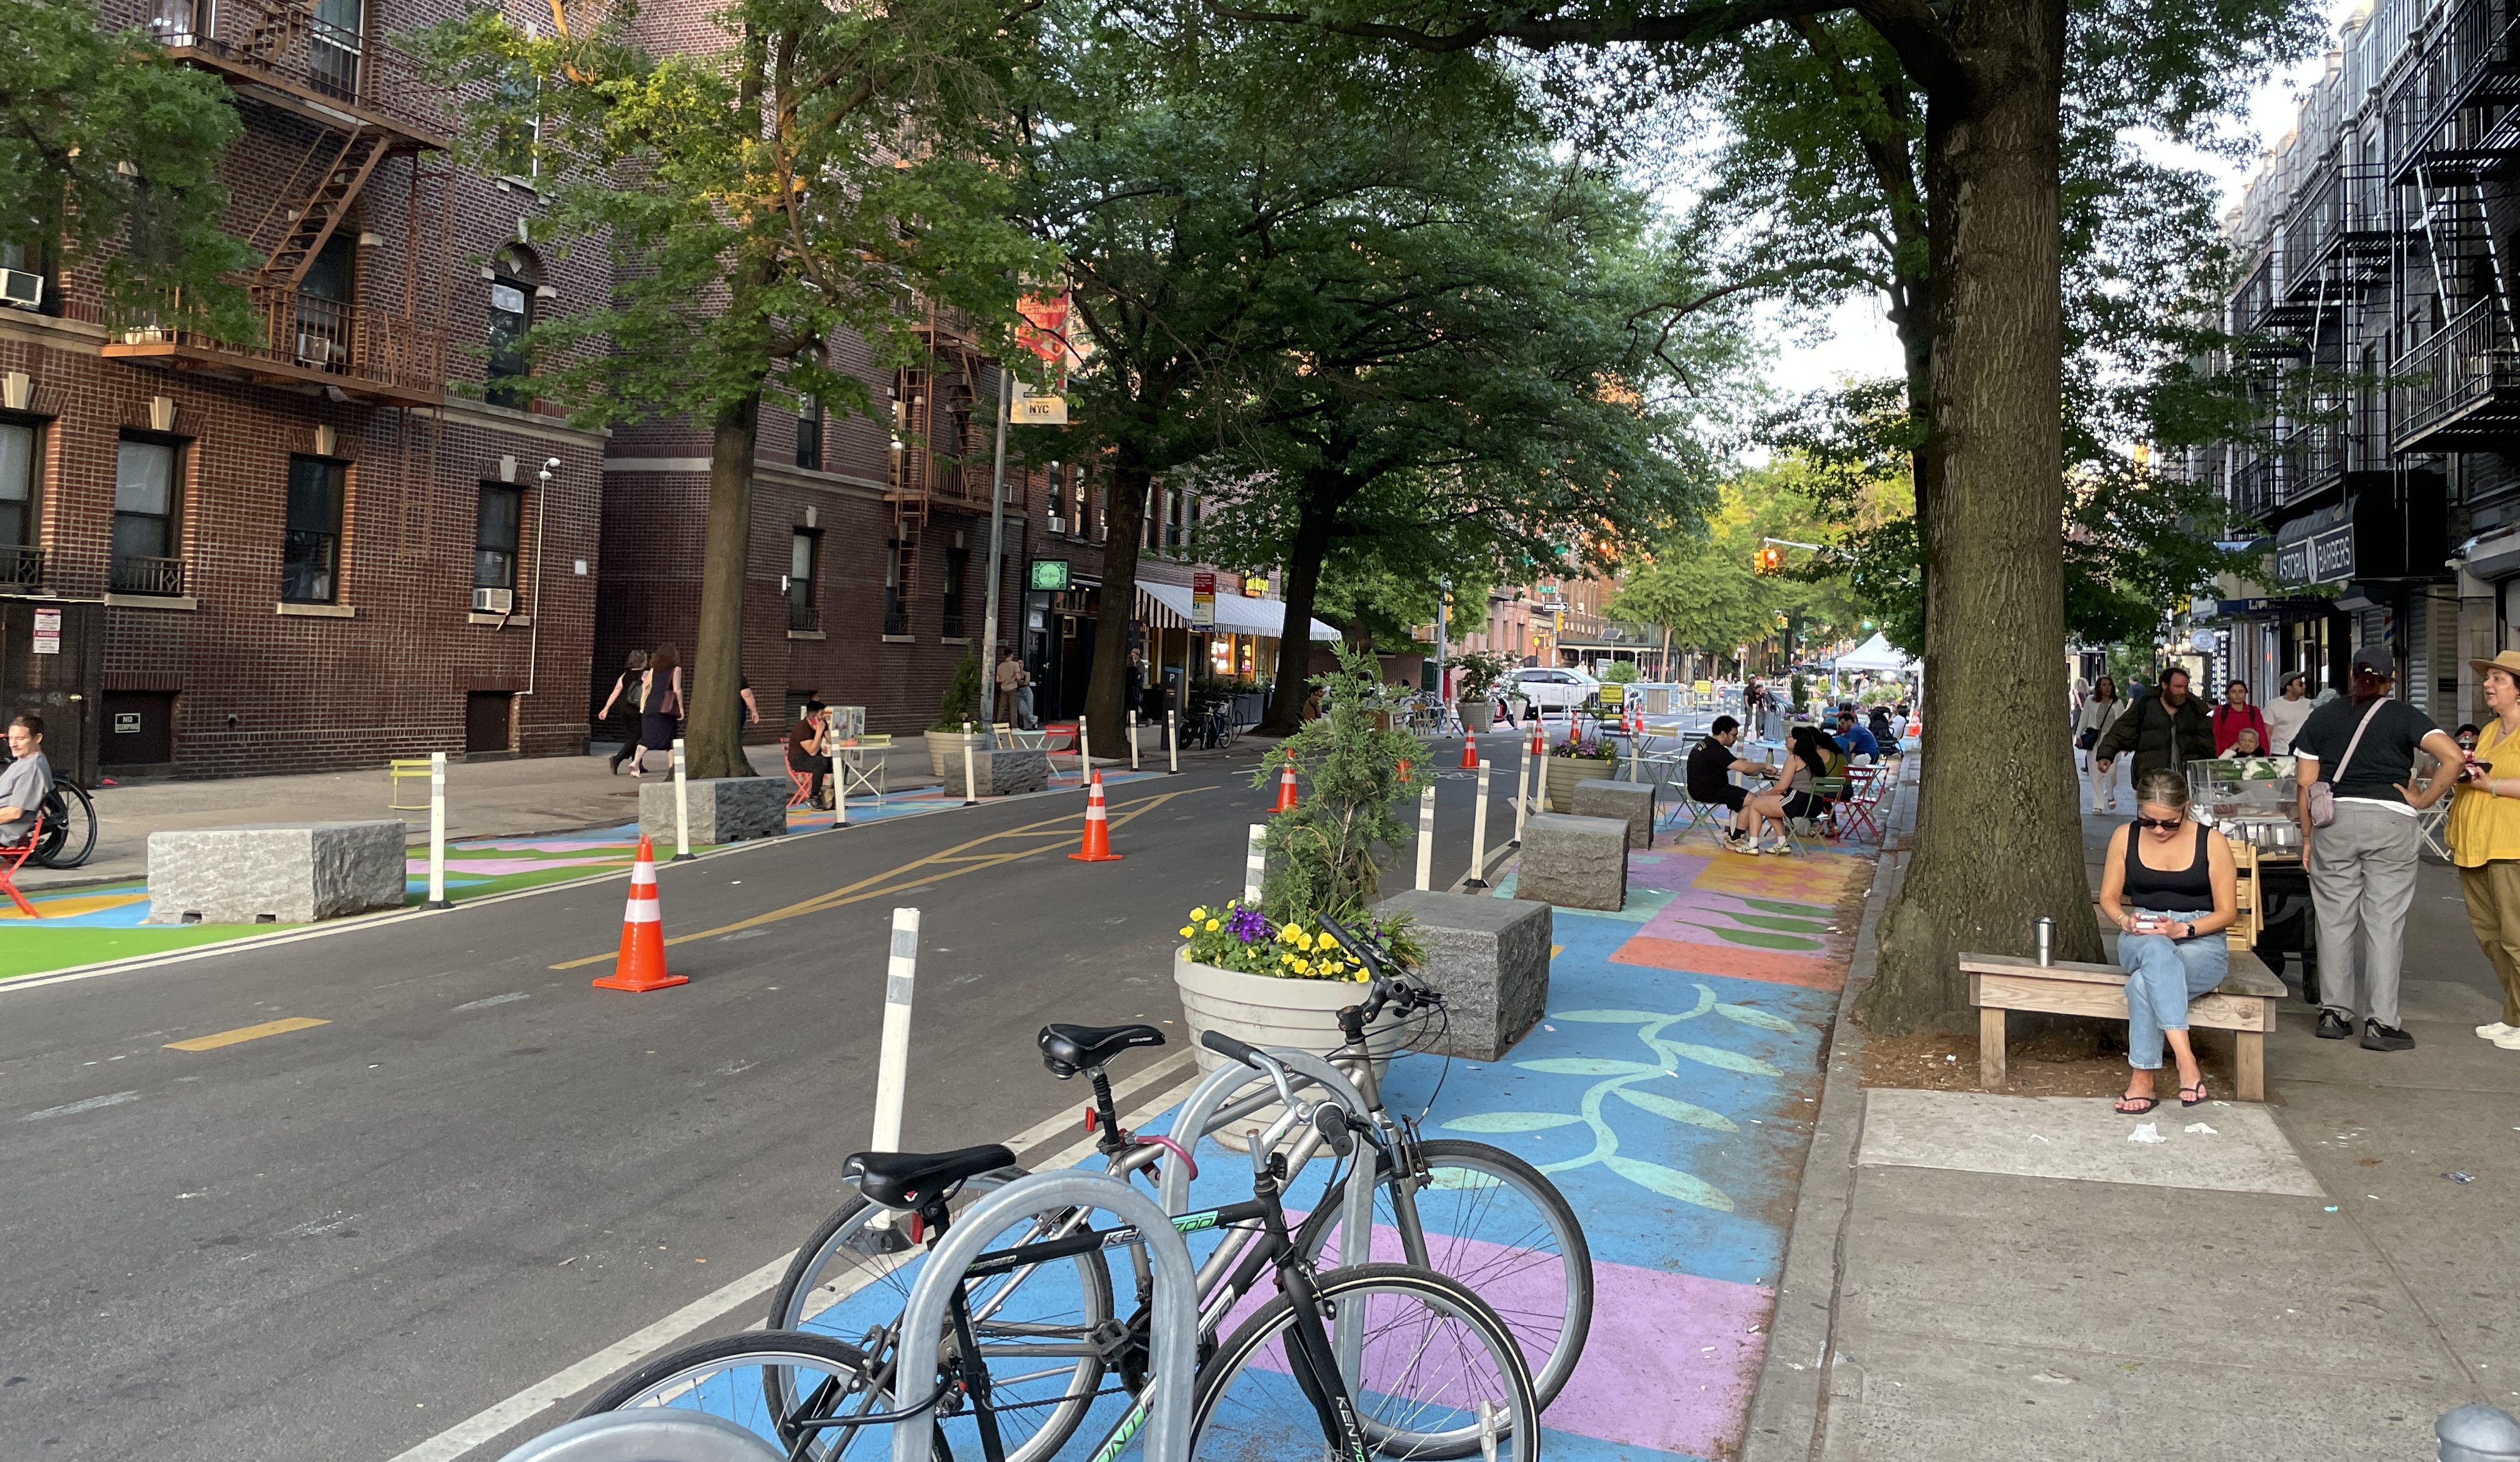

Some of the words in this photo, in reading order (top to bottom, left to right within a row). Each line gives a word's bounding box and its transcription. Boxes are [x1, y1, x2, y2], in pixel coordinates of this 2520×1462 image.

[1029, 404, 1049, 414] NYC
[2279, 551, 2306, 581] ASTORIA
[2318, 536, 2350, 573] BARBERS
[1169, 673, 1175, 682] P
[1336, 1396, 1363, 1450] KENT
